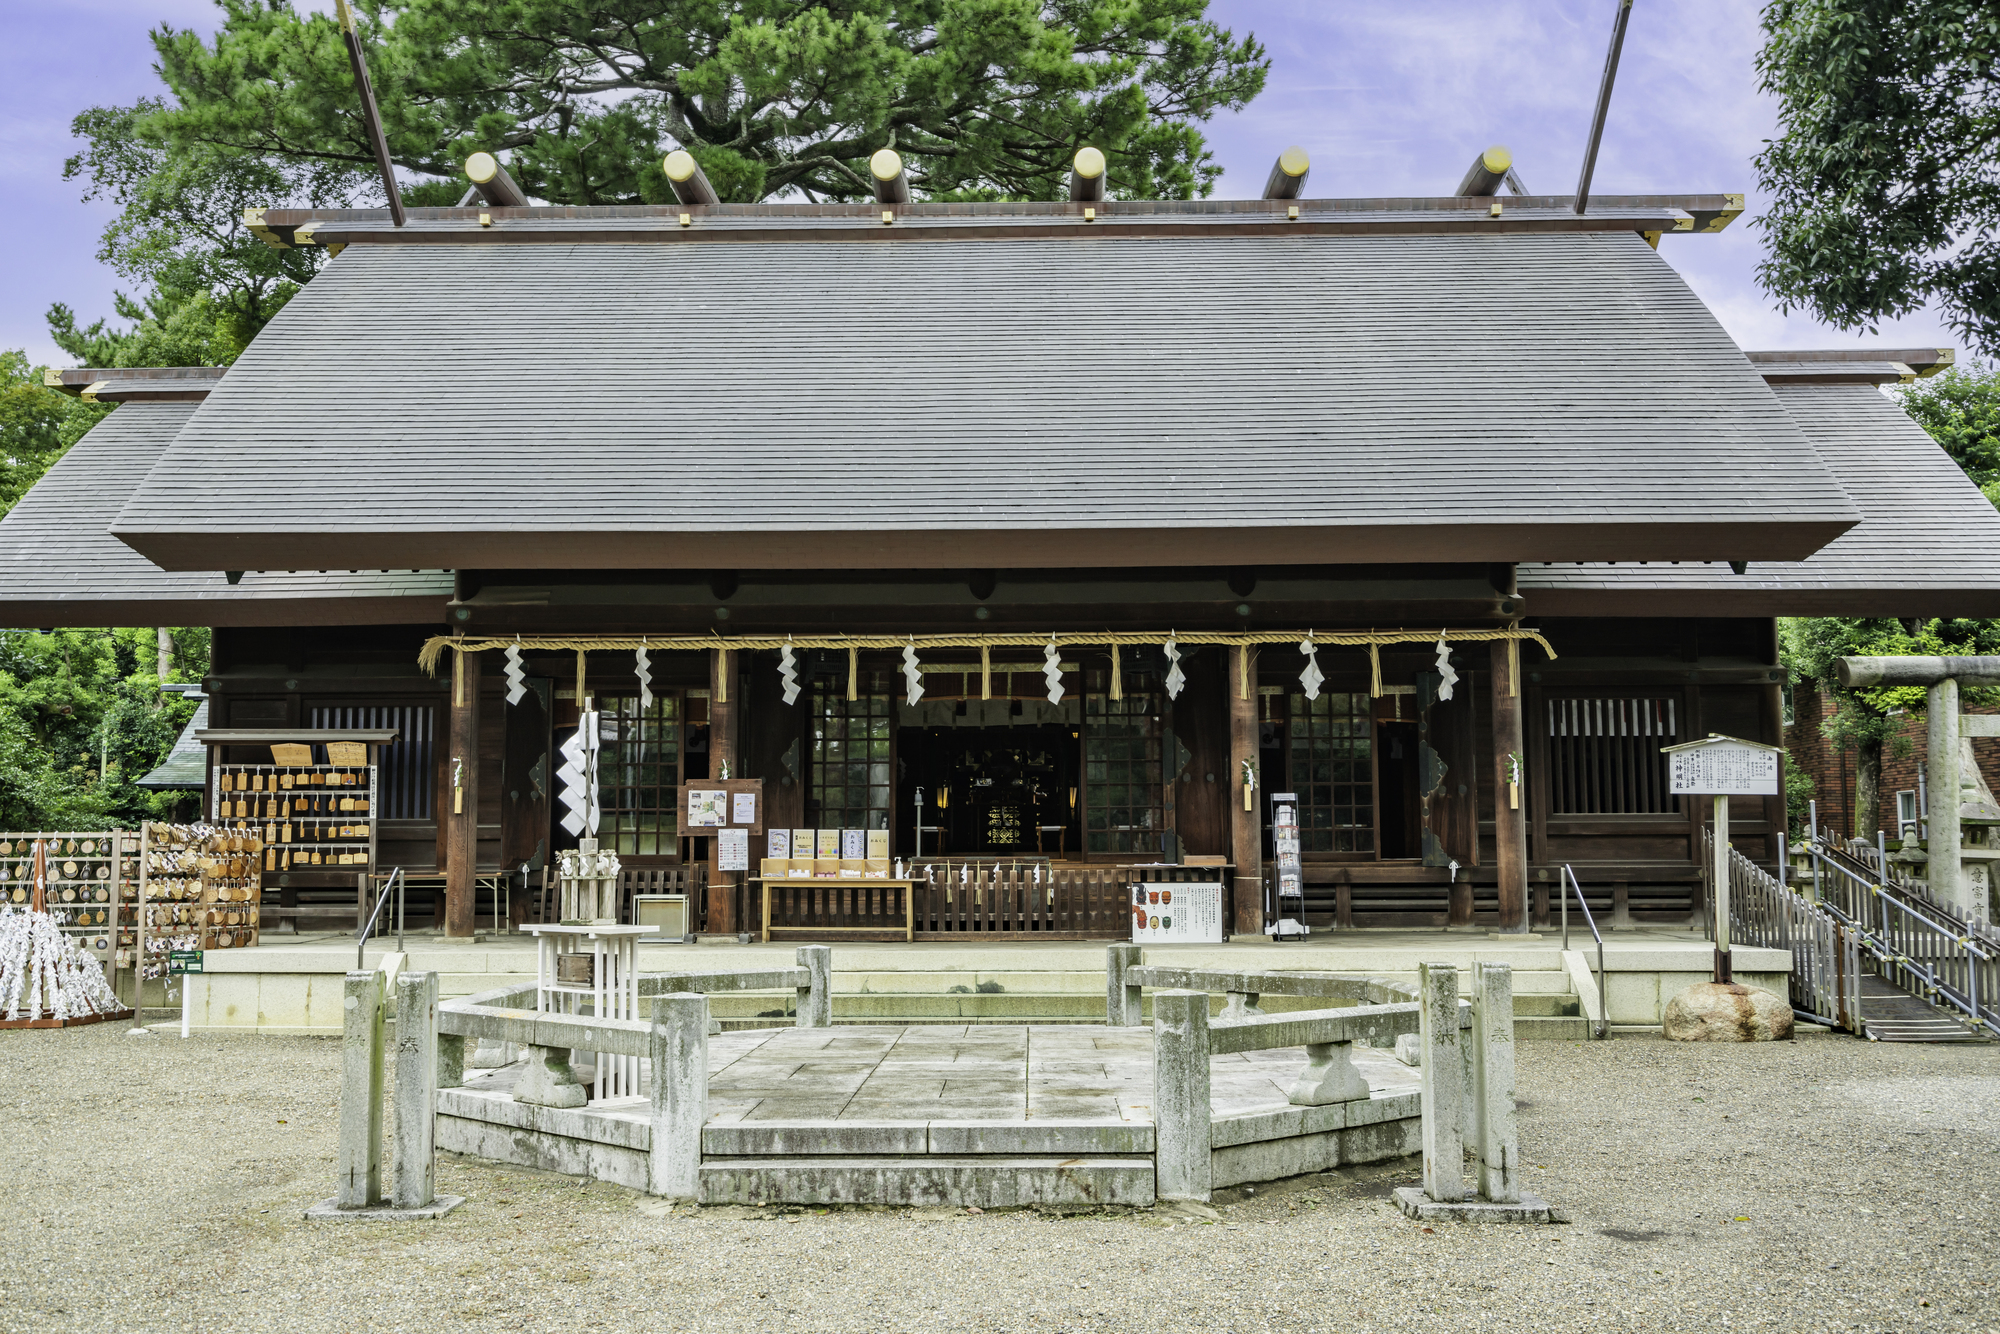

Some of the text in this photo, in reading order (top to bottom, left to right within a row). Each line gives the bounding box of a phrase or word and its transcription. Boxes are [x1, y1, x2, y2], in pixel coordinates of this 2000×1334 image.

[1675, 764, 1683, 789] 神明社
[400, 1036, 419, 1053] 奉
[1491, 1027, 1511, 1046] 奉
